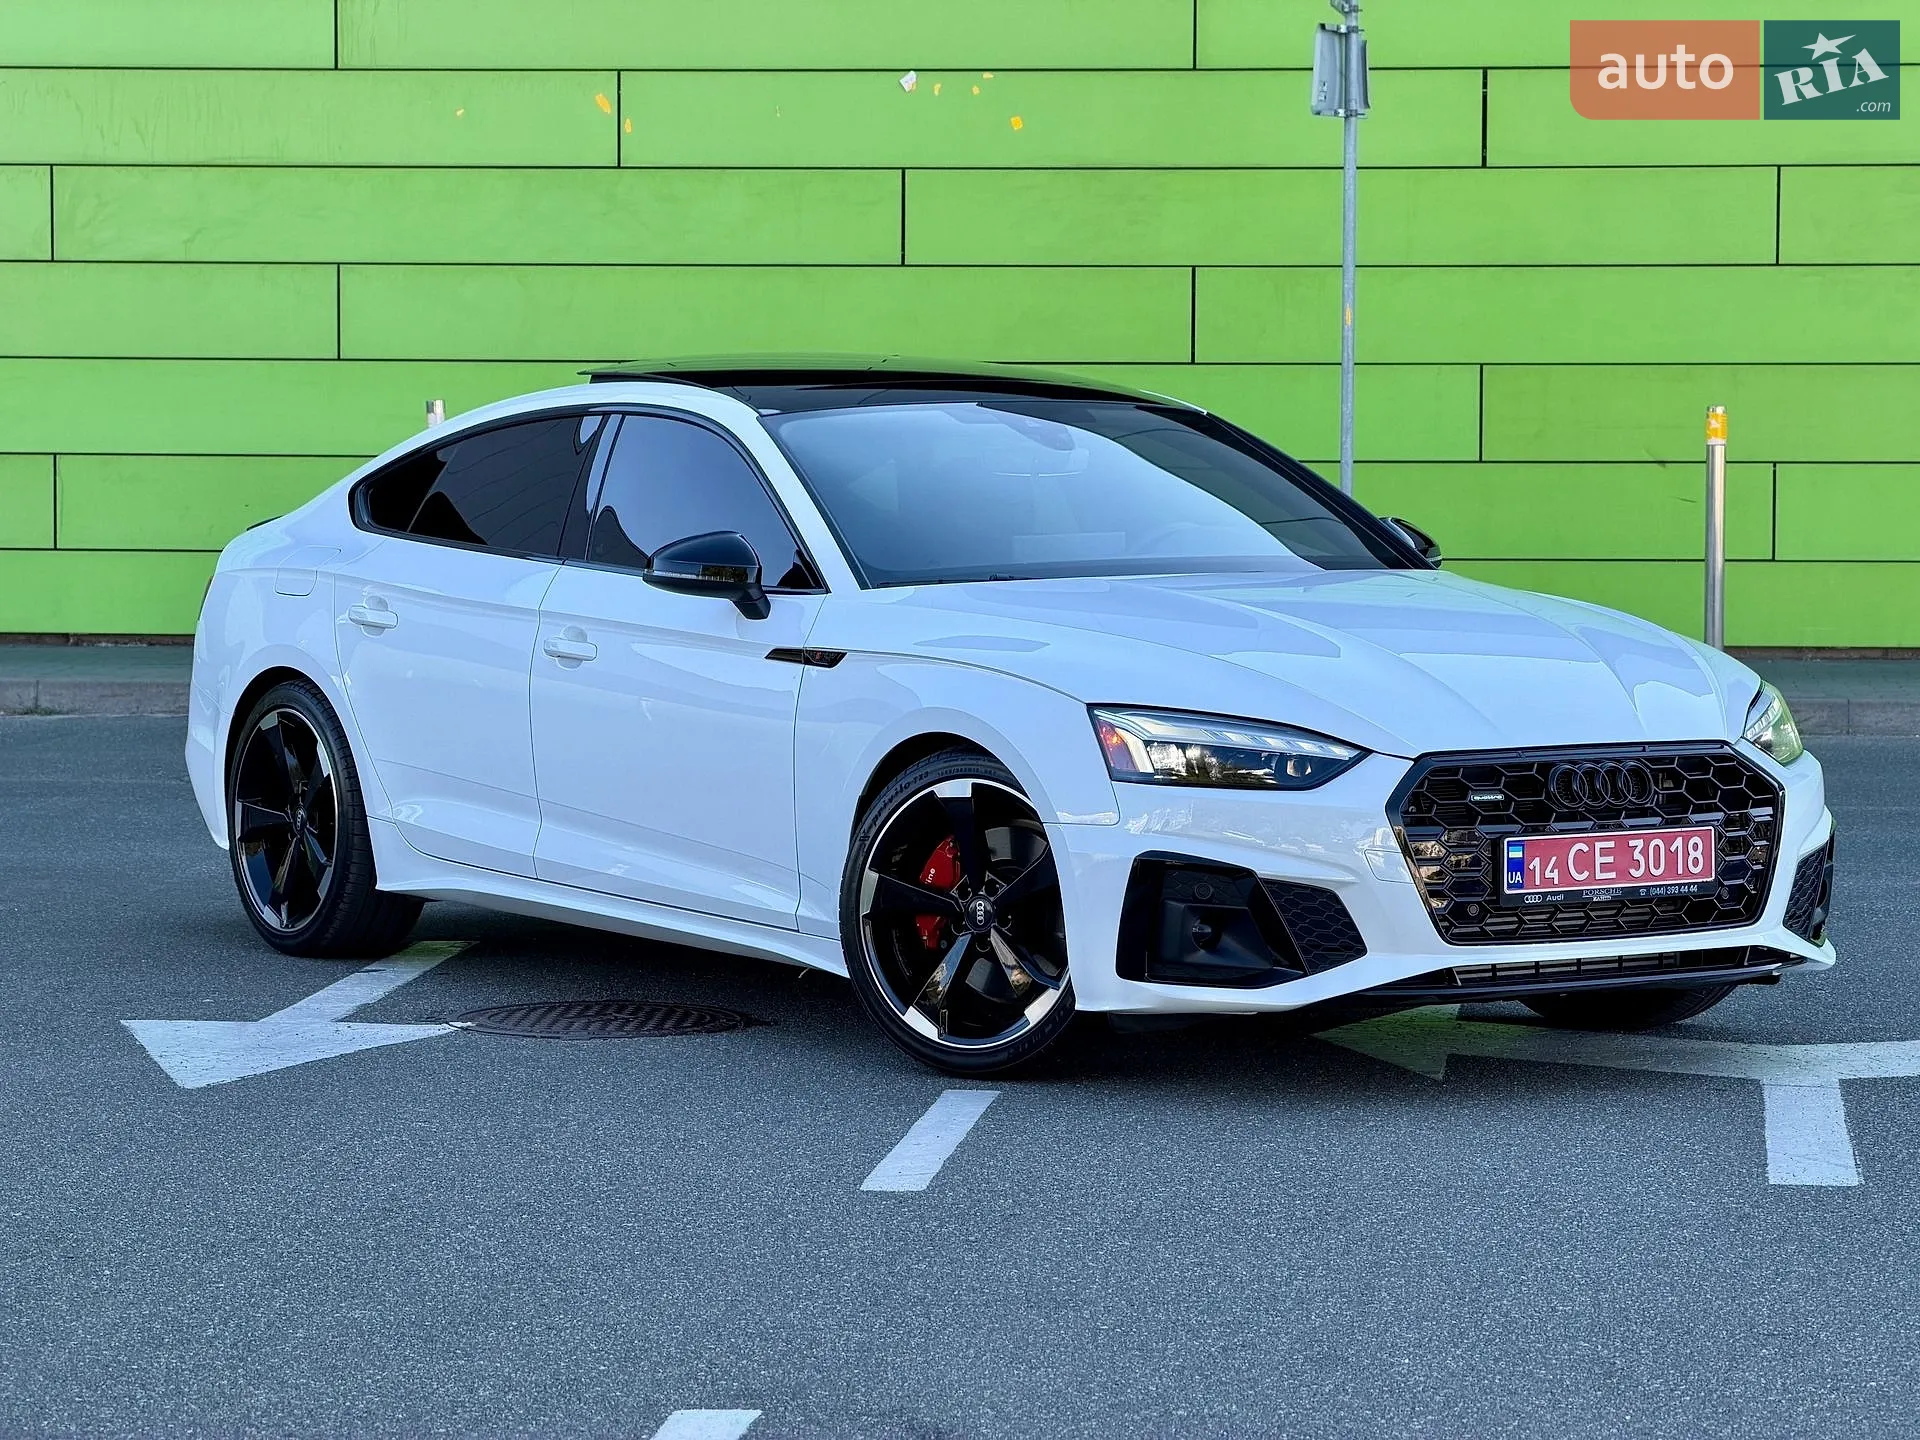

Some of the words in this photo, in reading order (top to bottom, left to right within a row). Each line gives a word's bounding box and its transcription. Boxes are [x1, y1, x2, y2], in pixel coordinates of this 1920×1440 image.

[1528, 856, 1559, 886] 14
[1567, 841, 1617, 882] CE
[1628, 836, 1704, 878] 3018
[1508, 871, 1523, 884] UA
[1583, 888, 1623, 896] PORSCHE
[1649, 887, 1666, 896] (044)
[1667, 886, 1679, 894] 393
[1680, 885, 1688, 893] 44
[1689, 884, 1698, 893] 44
[1546, 893, 1564, 901] Audi
